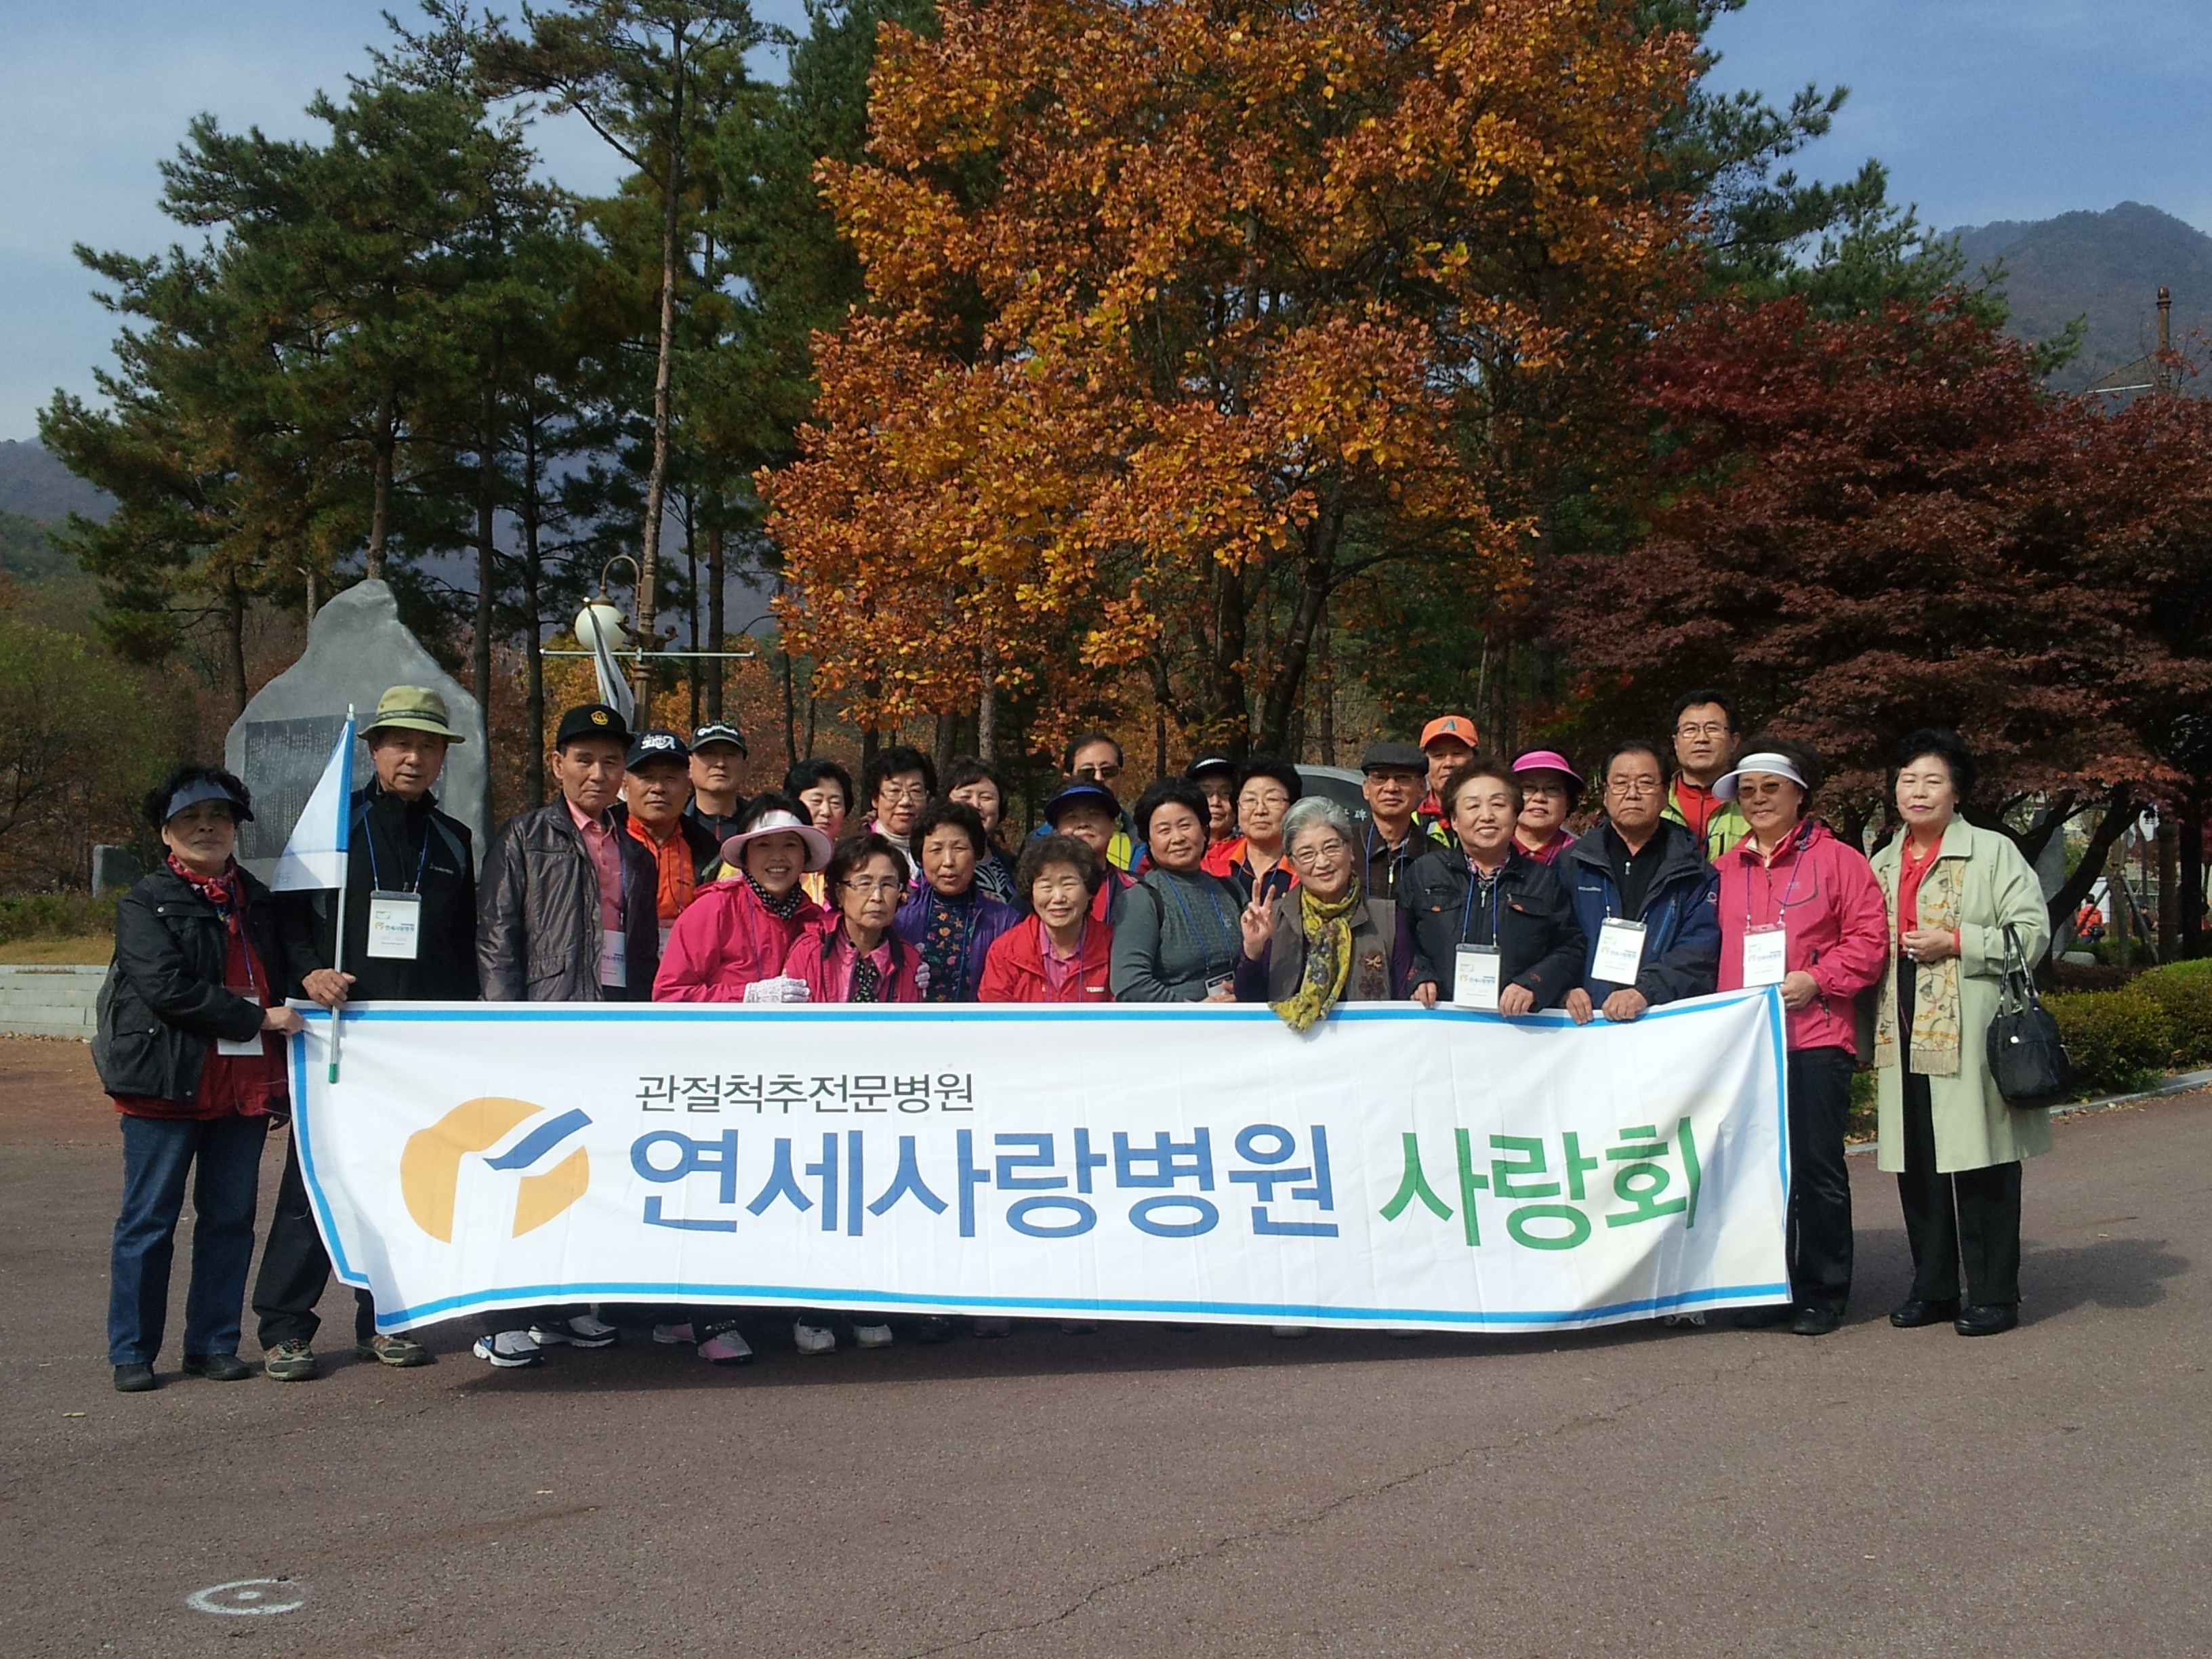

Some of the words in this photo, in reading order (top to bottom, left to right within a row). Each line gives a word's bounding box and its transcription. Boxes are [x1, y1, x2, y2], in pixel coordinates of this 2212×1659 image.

[1438, 718, 1457, 733] A
[635, 1073, 974, 1113] 관절척추전문병원
[630, 1123, 1339, 1239] 연세사랑병원
[1379, 1116, 1702, 1251] 사랑회
